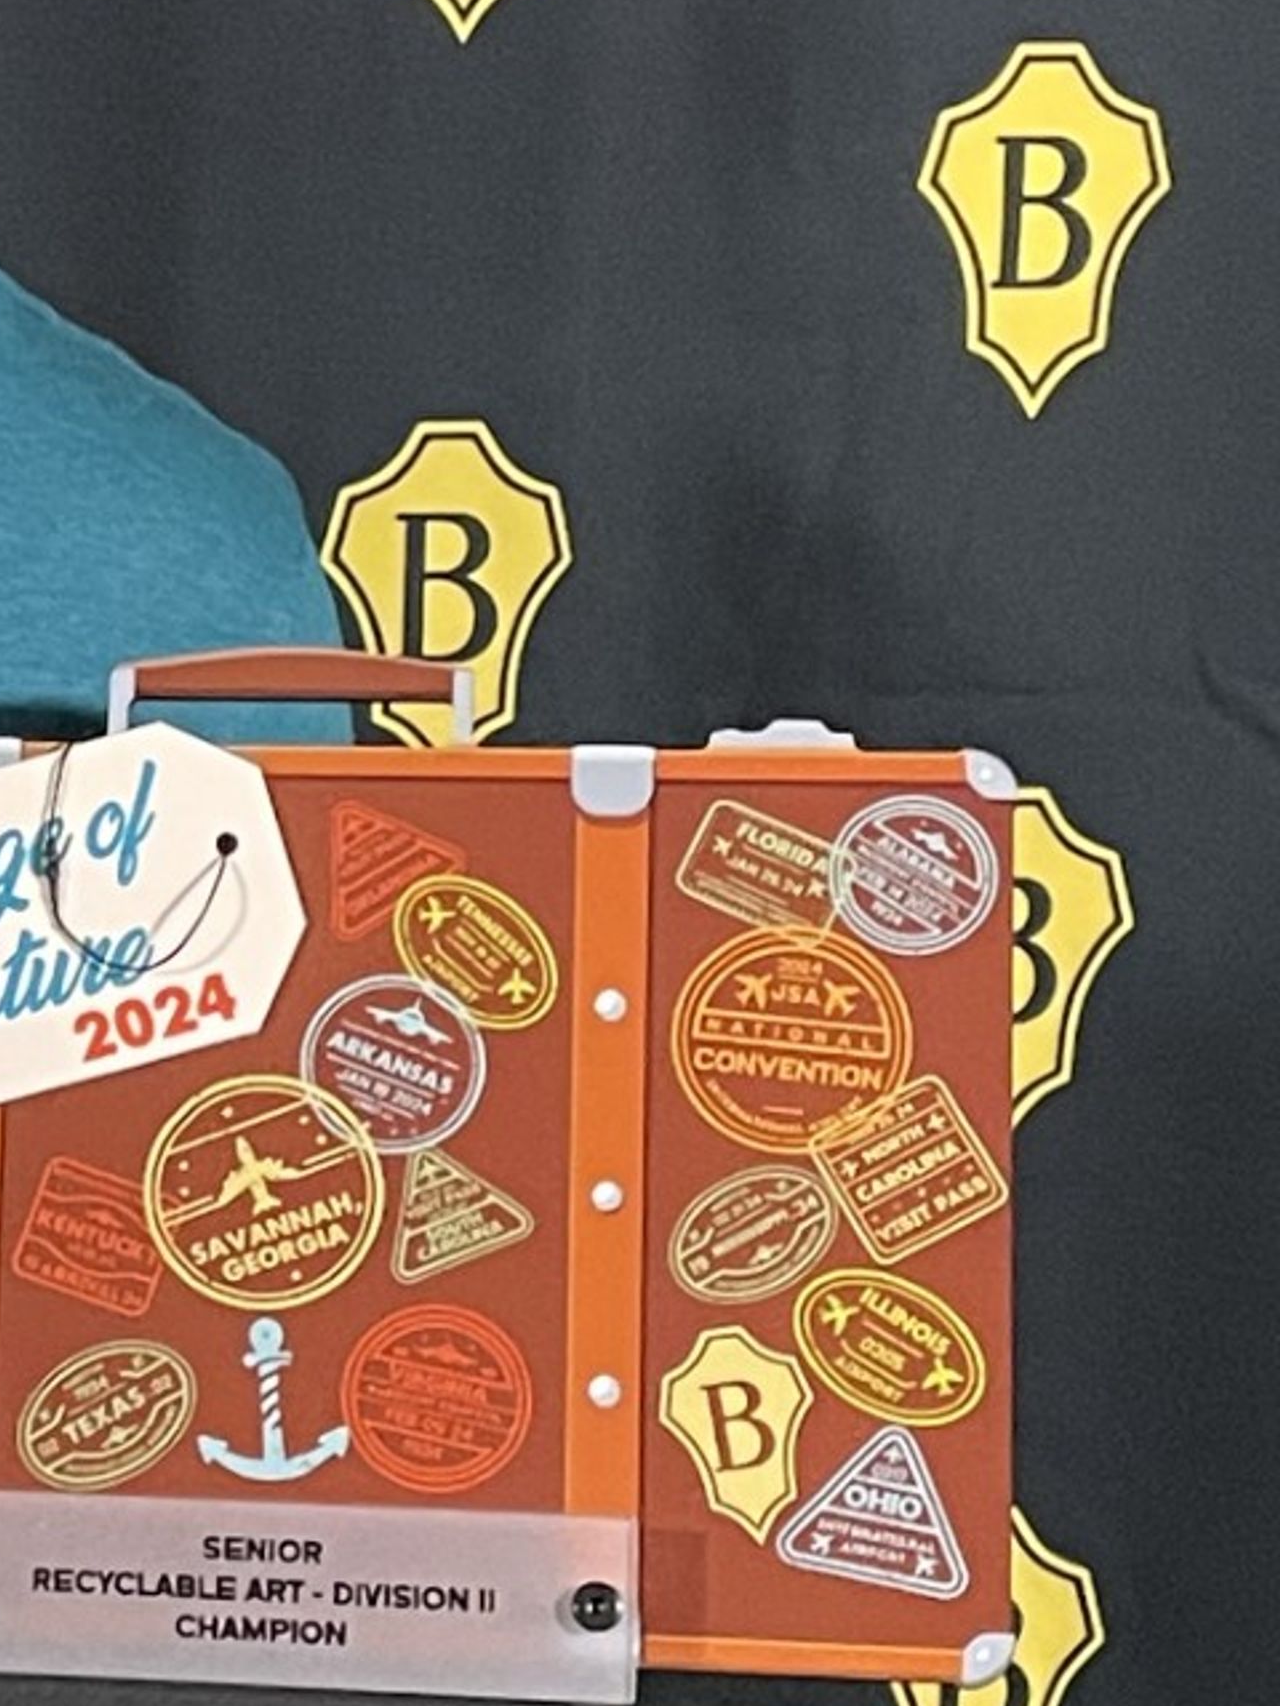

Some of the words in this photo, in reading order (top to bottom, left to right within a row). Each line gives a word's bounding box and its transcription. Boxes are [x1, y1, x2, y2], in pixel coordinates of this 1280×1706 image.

[993, 138, 1090, 288] B
[397, 514, 497, 662] B
[85, 760, 158, 886] of
[736, 820, 833, 879] FLORIDA
[456, 894, 534, 968] TENNESSEE
[73, 971, 237, 1063] 2024
[704, 1017, 876, 1050] NATIONAL
[325, 1030, 455, 1095] ARKANSAS
[692, 1046, 883, 1090] CONVENTION
[855, 1139, 962, 1203] CAROLINA
[861, 1124, 926, 1165] NORTH
[931, 1174, 989, 1212] PASS
[190, 1191, 364, 1266] SAVANNAH,
[220, 1222, 351, 1282] GEORGIA
[858, 1286, 952, 1357] ILLINOIS
[61, 1385, 146, 1444] TEXAS
[699, 1378, 775, 1474] B
[843, 1483, 923, 1523] OHIO
[203, 1535, 323, 1565] SENIOR
[31, 1566, 238, 1603] RECYCLABLE
[246, 1577, 305, 1606] ART
[332, 1582, 477, 1614] DIVISION
[478, 1587, 496, 1614] II
[174, 1615, 347, 1648] CHAMPION
